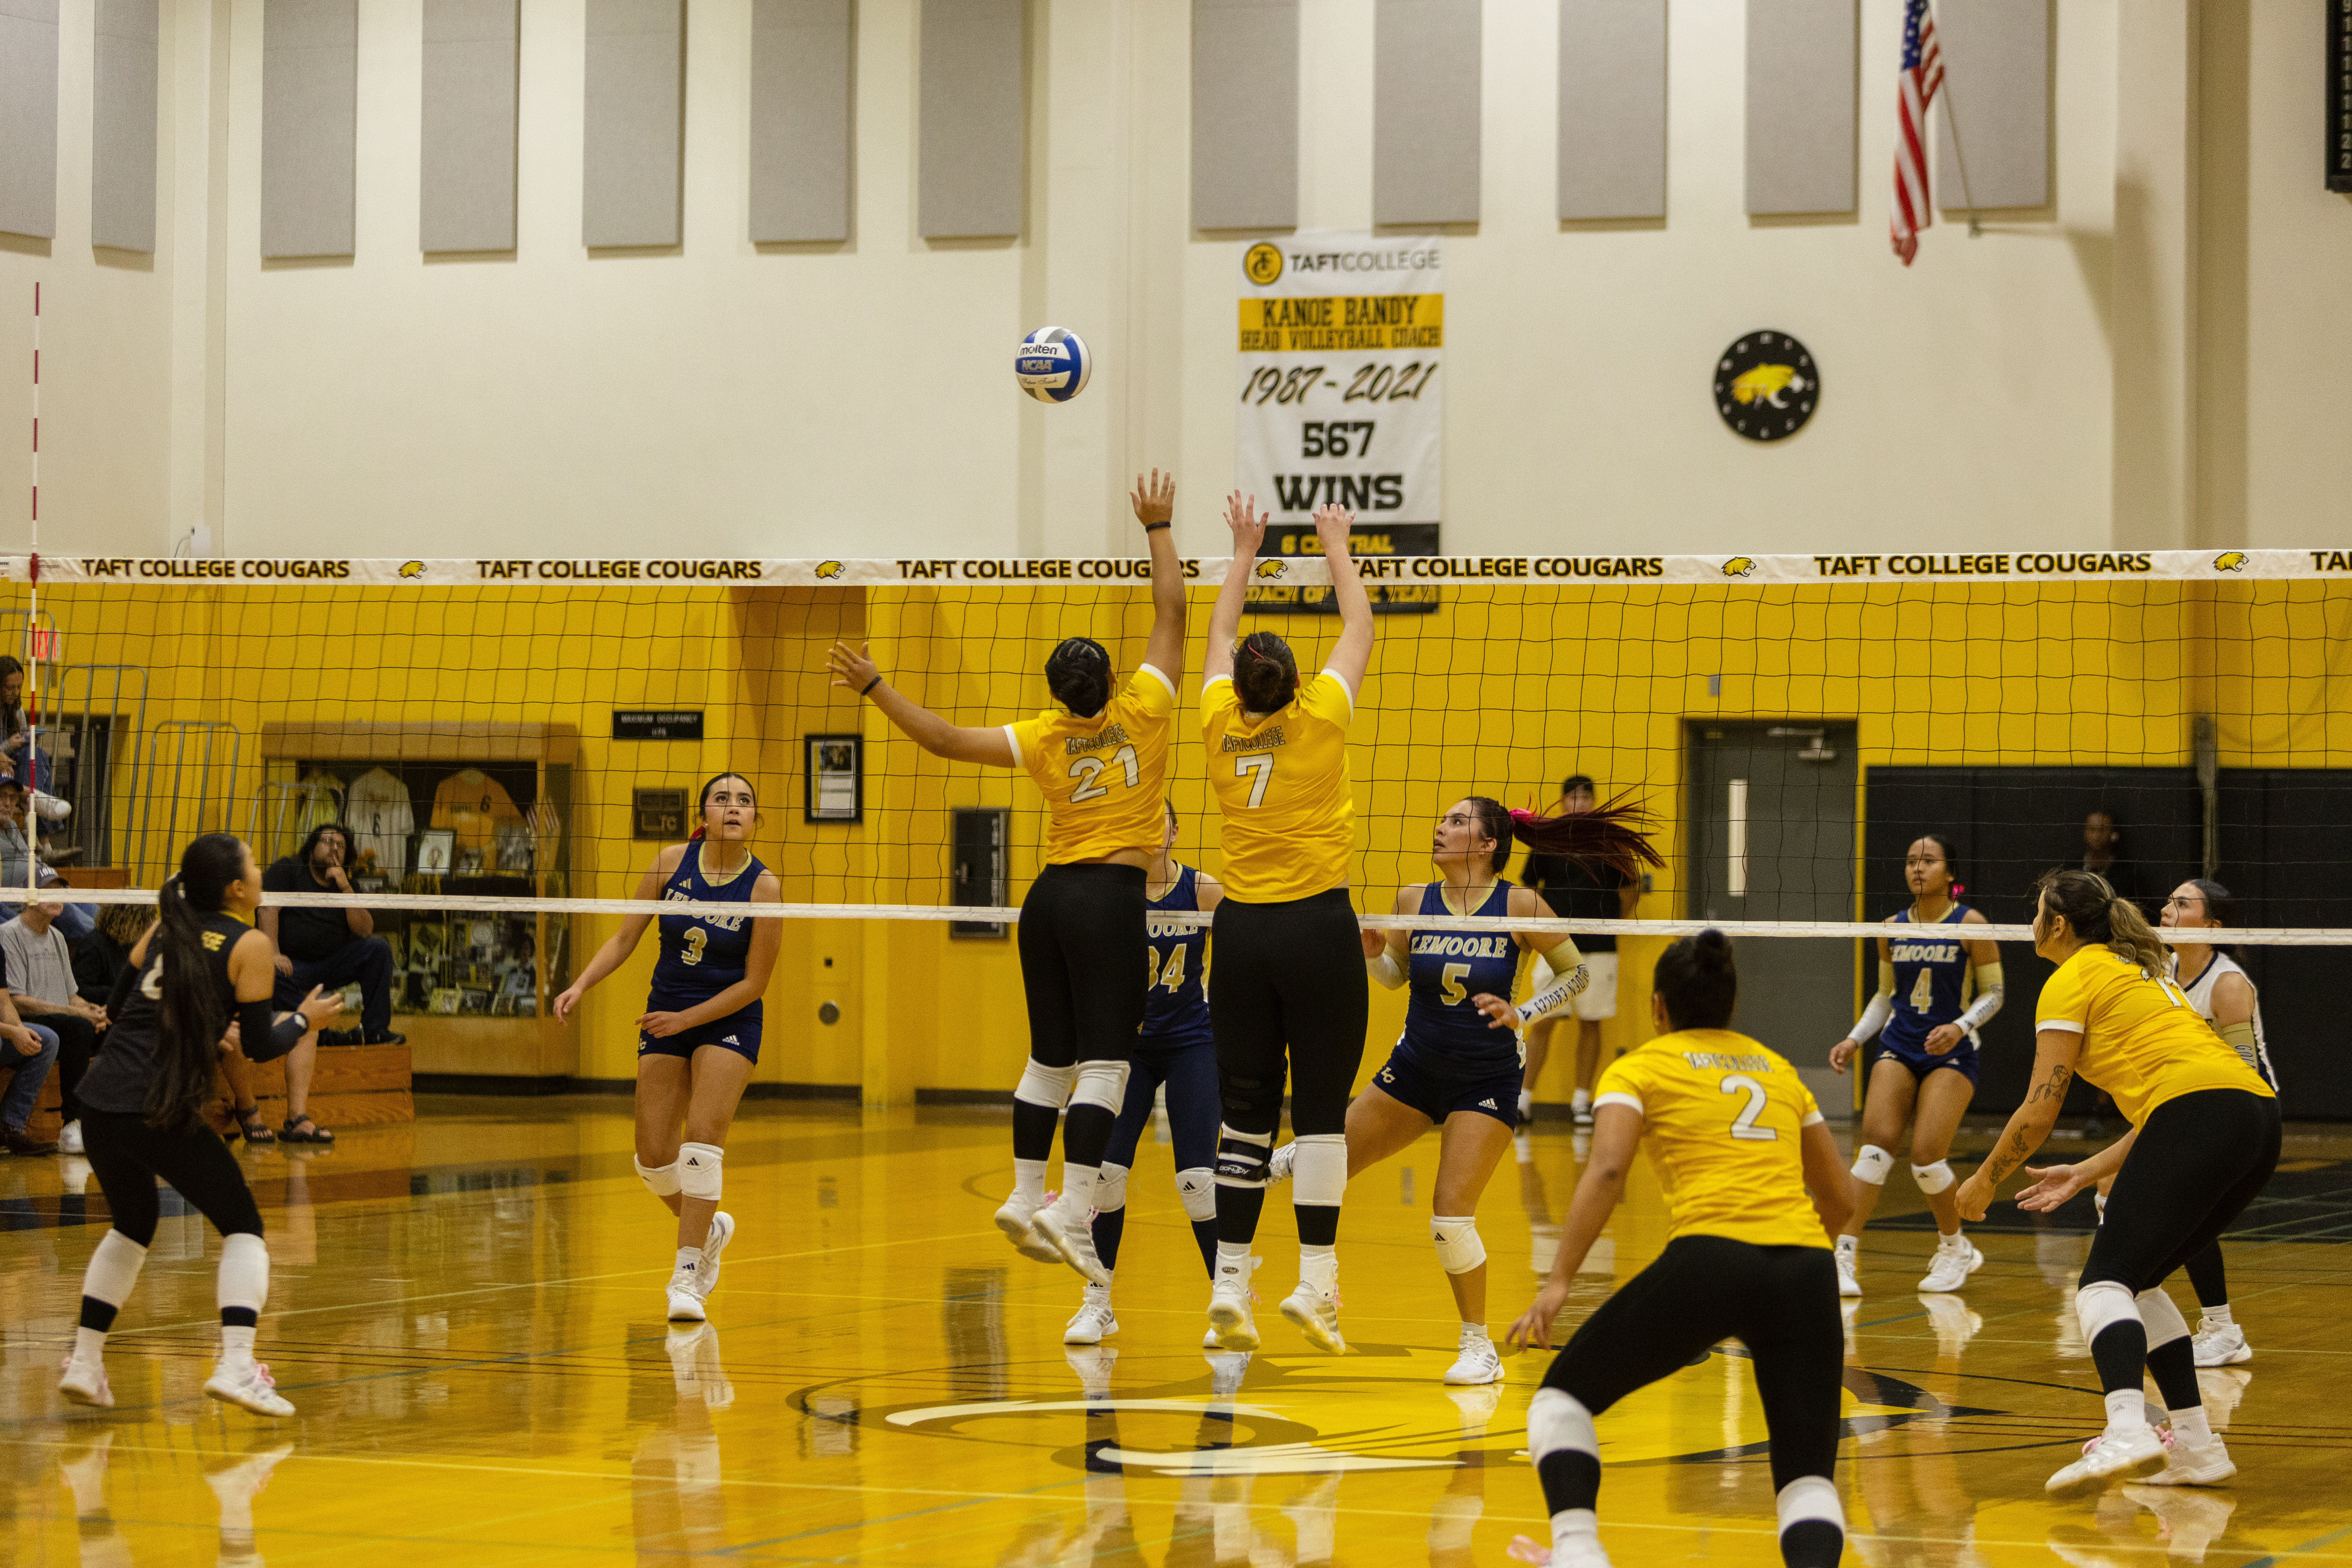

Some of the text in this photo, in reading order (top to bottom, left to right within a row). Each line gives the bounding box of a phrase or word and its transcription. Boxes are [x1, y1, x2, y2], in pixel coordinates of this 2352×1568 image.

[1263, 296, 1419, 327] KANOE BANDY
[1241, 325, 1441, 350] HEAD VOLLEYBALL COACH
[1020, 345, 1057, 356] molten
[1022, 359, 1052, 372] NCAA
[1302, 421, 1375, 457] 567
[1274, 474, 1403, 510] WINS
[82, 559, 350, 578] TAFT COLLEGE COUGARS
[476, 560, 762, 579] TAFT COLLEGE COUGARS
[897, 559, 1200, 579] TAFT COLLEGE COUGS
[1412, 558, 1528, 578] COLLEGE
[1534, 558, 1664, 577] COUGARS
[1813, 553, 2152, 576] TAFT COLLEGE COUGARS
[1069, 744, 1139, 804] 21
[1235, 752, 1274, 809] 7
[681, 926, 707, 965] 3
[1411, 935, 1508, 958] LEMOORE
[1440, 962, 1471, 1006] 5
[1910, 967, 1933, 1014] 4
[722, 1037, 740, 1046] adidas
[1479, 1101, 1498, 1110] adidas
[1720, 1074, 1778, 1141] 2
[1220, 1165, 1249, 1174] DONJOY
